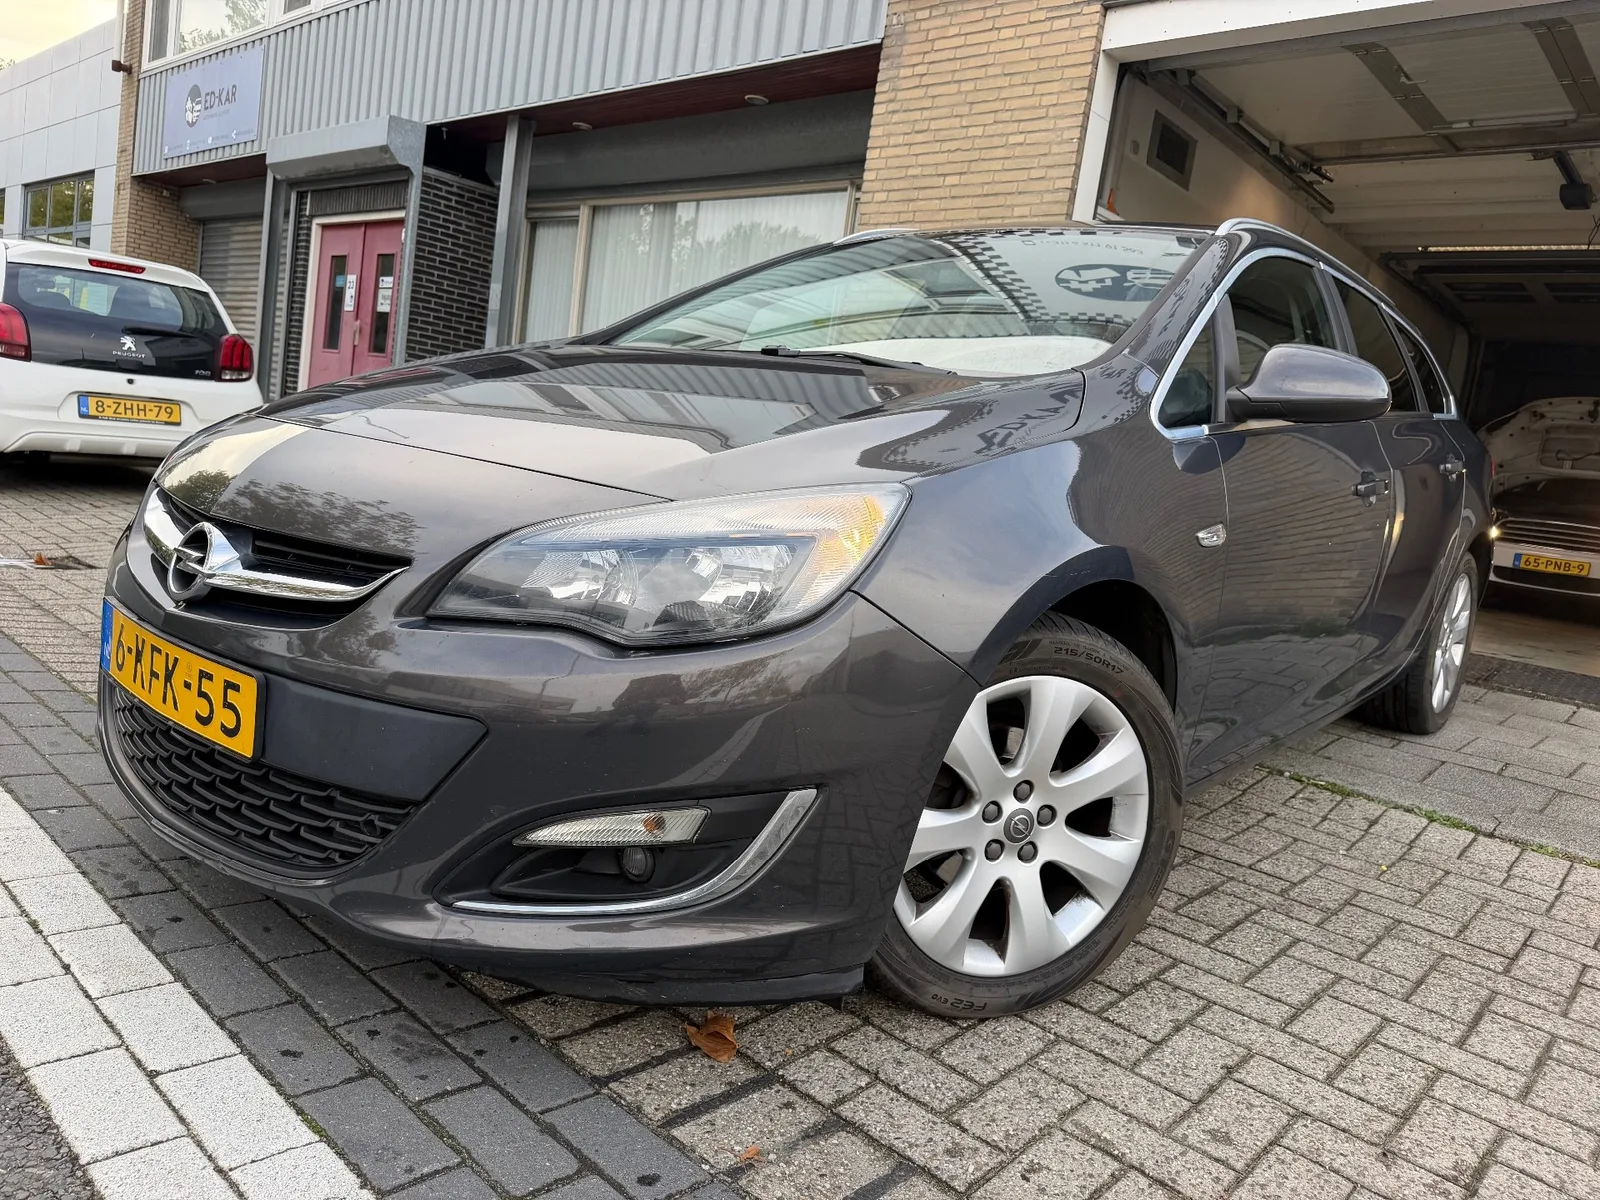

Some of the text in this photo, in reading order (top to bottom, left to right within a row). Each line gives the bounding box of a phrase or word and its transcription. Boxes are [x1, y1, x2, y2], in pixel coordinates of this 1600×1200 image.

[204, 84, 237, 111] ED-KAR
[112, 350, 146, 359] PEUGEOT
[95, 399, 174, 419] 8-ZHH-79
[1523, 556, 1585, 574] 65-PNB-9
[1053, 646, 1125, 674] 215/50R17
[115, 623, 242, 738] 6-KFK-55
[931, 993, 949, 1005] EVO
